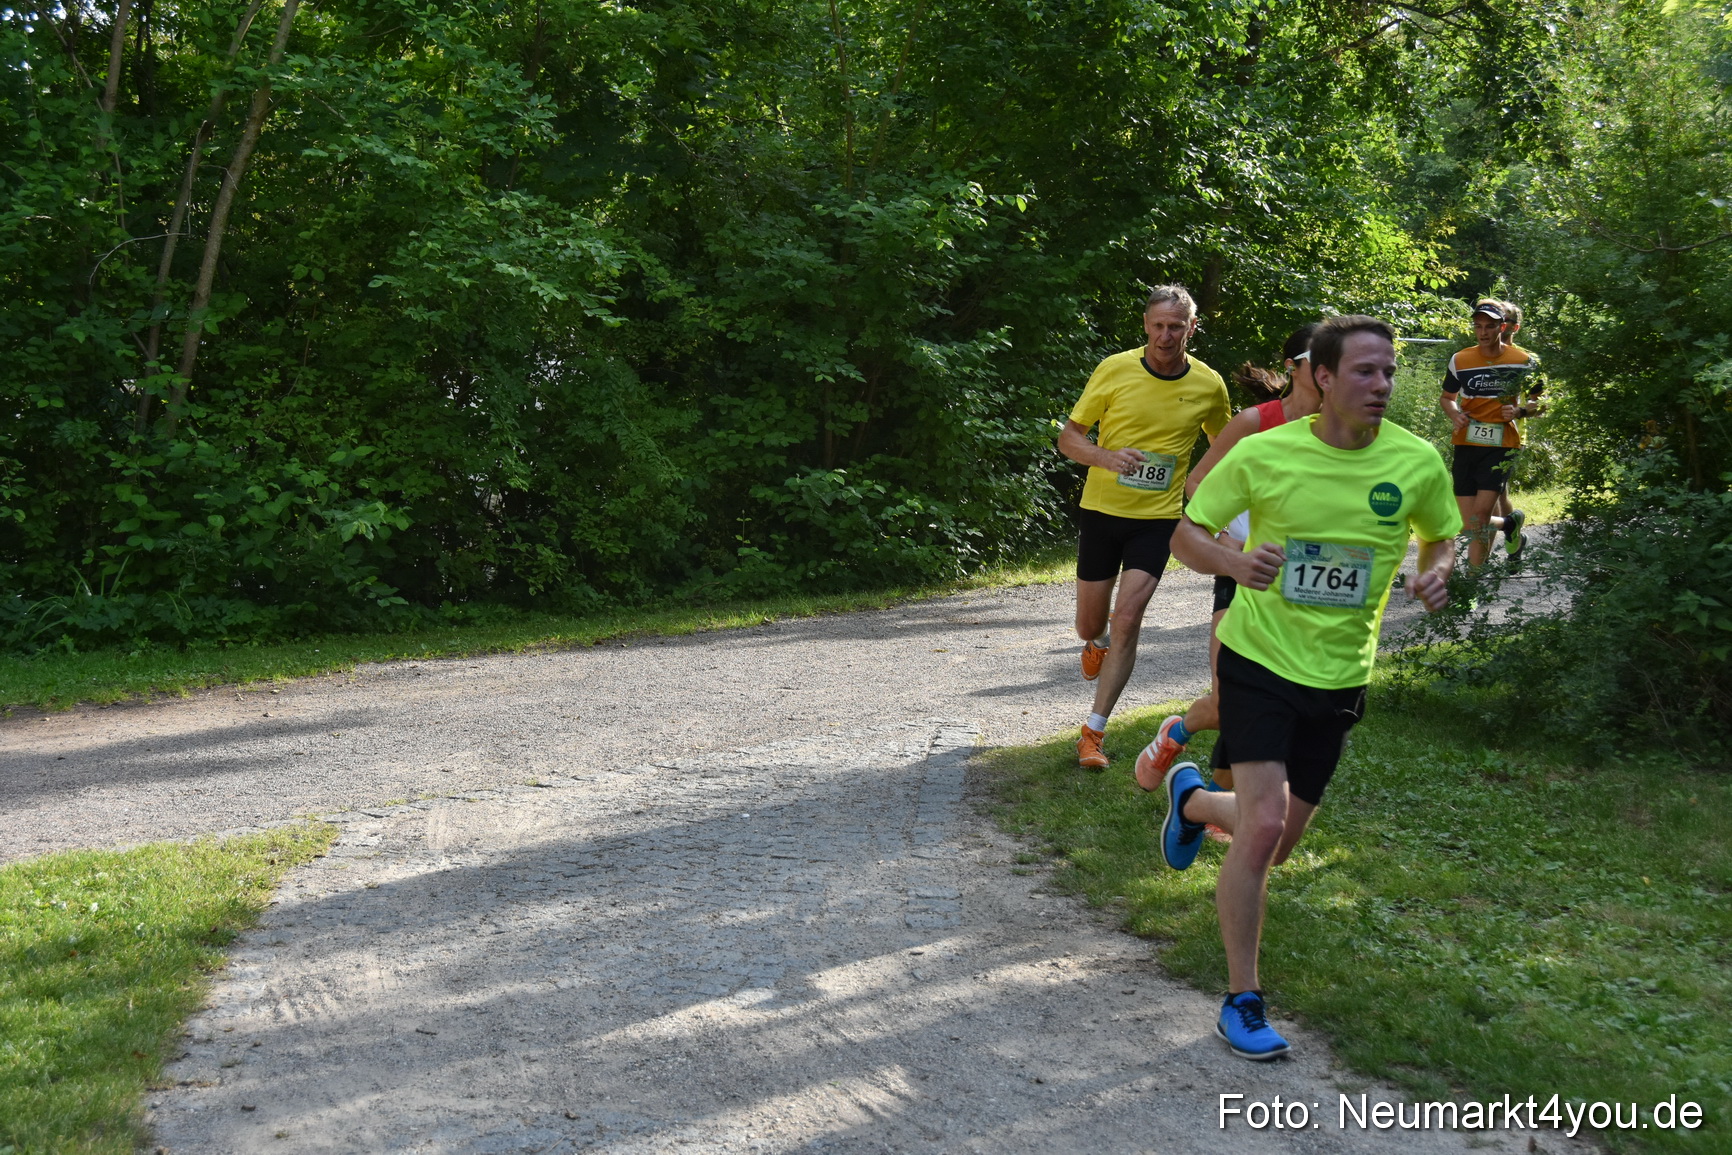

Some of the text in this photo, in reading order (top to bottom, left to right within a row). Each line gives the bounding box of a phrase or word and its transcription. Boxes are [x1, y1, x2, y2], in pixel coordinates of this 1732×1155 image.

[1474, 426, 1494, 438] 751
[1294, 563, 1359, 592] 1764
[1321, 590, 1354, 599] Johannes
